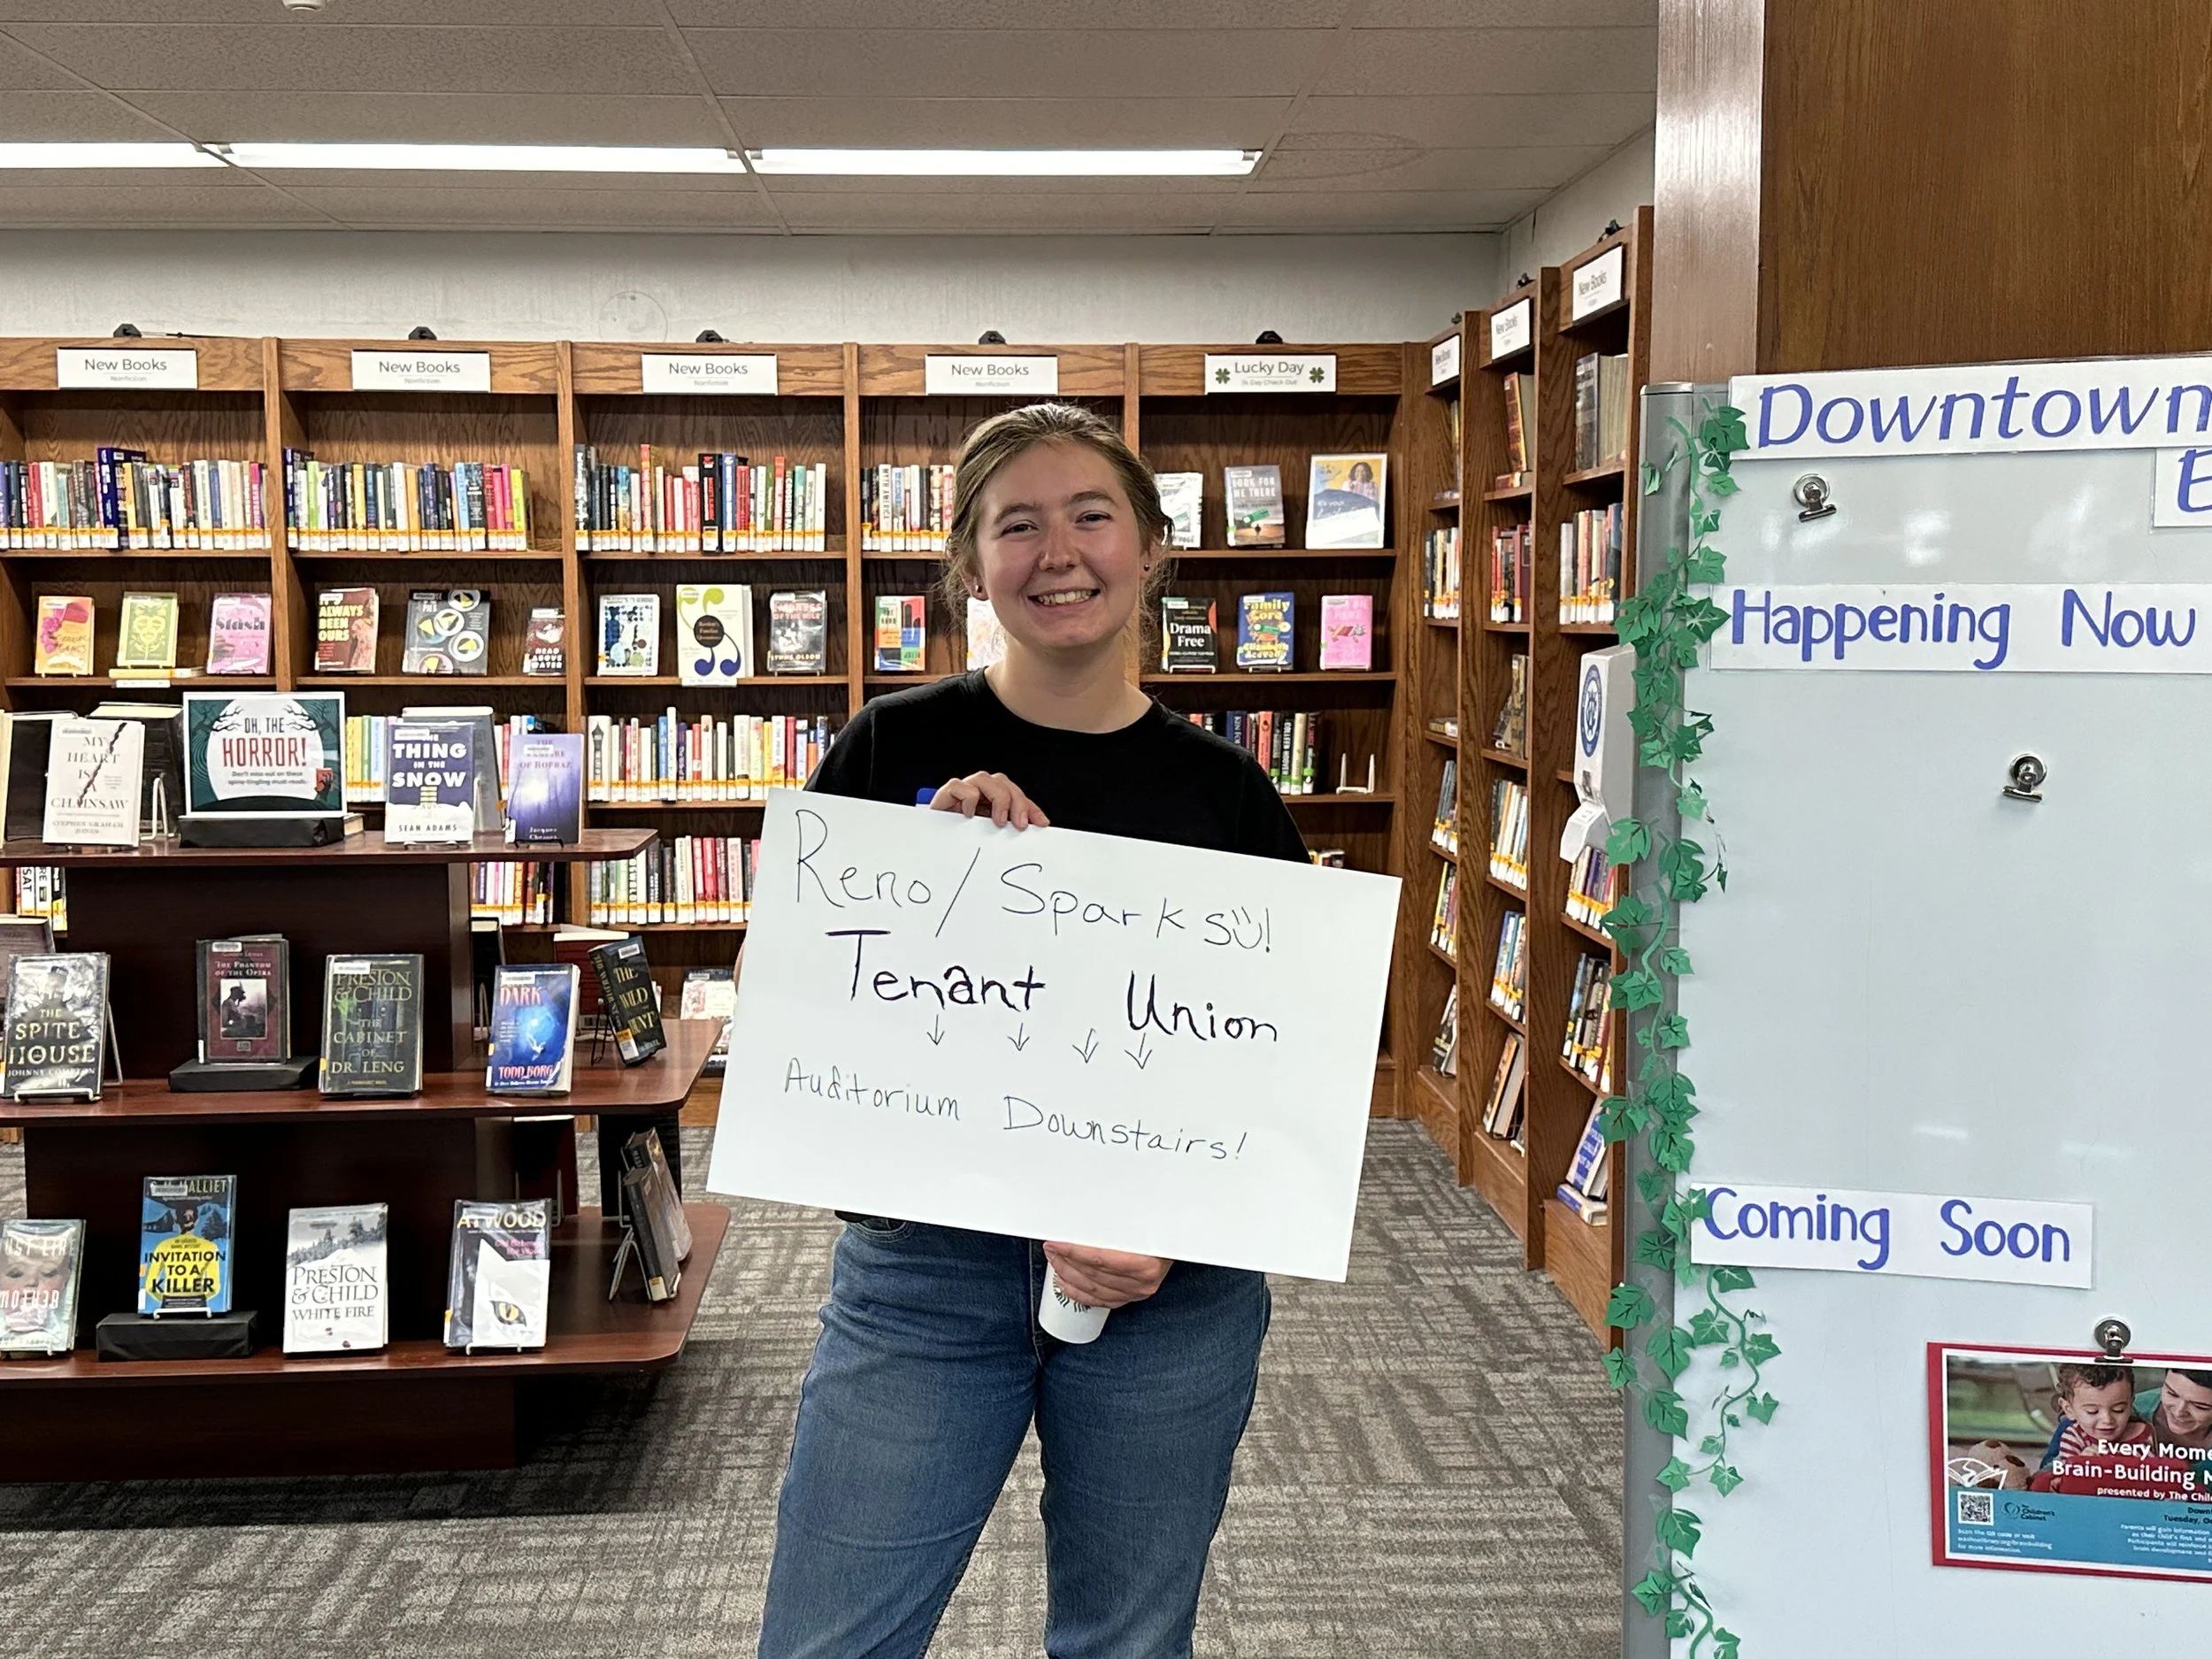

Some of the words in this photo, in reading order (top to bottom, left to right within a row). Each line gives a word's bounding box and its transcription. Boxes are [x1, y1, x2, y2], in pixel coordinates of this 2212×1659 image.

[85, 358, 118, 371] New
[122, 357, 167, 371] Books
[379, 361, 412, 373] New
[416, 360, 461, 373] Books
[669, 363, 702, 374] New
[705, 362, 749, 375] Books
[951, 364, 983, 375] New
[987, 364, 1029, 376] Books
[1234, 361, 1275, 375] Lucky
[1279, 361, 1305, 375] Day
[1758, 375, 2212, 449] Downtown
[1259, 476, 1275, 487] FOR
[1248, 488, 1277, 497] THERE
[319, 604, 364, 617] ALWAYS
[319, 618, 349, 630] BEEN
[1170, 623, 1211, 635] Drama
[1732, 585, 2011, 671] Happening
[2062, 588, 2197, 648] Now
[319, 629, 349, 641] OURS
[1177, 635, 1205, 648] Free
[244, 718, 262, 735] OH,
[265, 718, 285, 733] THE
[83, 737, 107, 747] MY
[1283, 721, 1292, 749] COLLEEN
[67, 752, 120, 764] HEART
[222, 737, 307, 768] HORROR!
[392, 743, 467, 758] THING
[1281, 750, 1291, 775] HOOVER
[78, 769, 91, 780] IS
[391, 772, 467, 787] SNOW
[335, 968, 412, 987] PRESTON
[612, 965, 639, 984] THE
[826, 929, 1047, 1011] Tenant
[1125, 970, 1279, 1043] Union
[334, 987, 352, 1002] &
[353, 986, 413, 1003] CHILD
[500, 987, 541, 1006] DARK
[618, 987, 649, 1010] WILD
[40, 1009, 63, 1018] THE
[360, 1018, 382, 1028] THE
[627, 1010, 656, 1035] HUNT
[15, 1022, 81, 1041] SPITE
[333, 1031, 407, 1044] CABINET
[9, 1045, 96, 1065] HOUSE
[361, 1048, 376, 1057] OF
[8, 1068, 44, 1078] JOHNNY
[363, 1061, 405, 1073] LENG
[499, 1064, 526, 1079] TODD
[526, 1064, 554, 1078] BORG
[784, 1057, 961, 1122] Auditorium
[1003, 1094, 1248, 1162] Downstairs!
[457, 1210, 548, 1229] ATWOOD
[1703, 1187, 1890, 1271] Coming
[1939, 1198, 2070, 1263] Soon
[144, 1250, 227, 1263] INVITATION
[166, 1264, 187, 1276] TO
[189, 1264, 200, 1275] A
[293, 1263, 378, 1286] PRESTON
[151, 1278, 215, 1294] KILLER
[291, 1286, 311, 1305] &
[311, 1284, 379, 1304] CHILD
[292, 1307, 342, 1321] WHITE
[345, 1305, 375, 1318] FIRE
[2098, 1439, 2151, 1461] Every
[2052, 1460, 2196, 1491] Brain-Building
[2097, 1487, 2150, 1498] presented
[2153, 1489, 2166, 1501] by
[2168, 1490, 2188, 1501] The
[2163, 1514, 2201, 1525] Tuesday,
